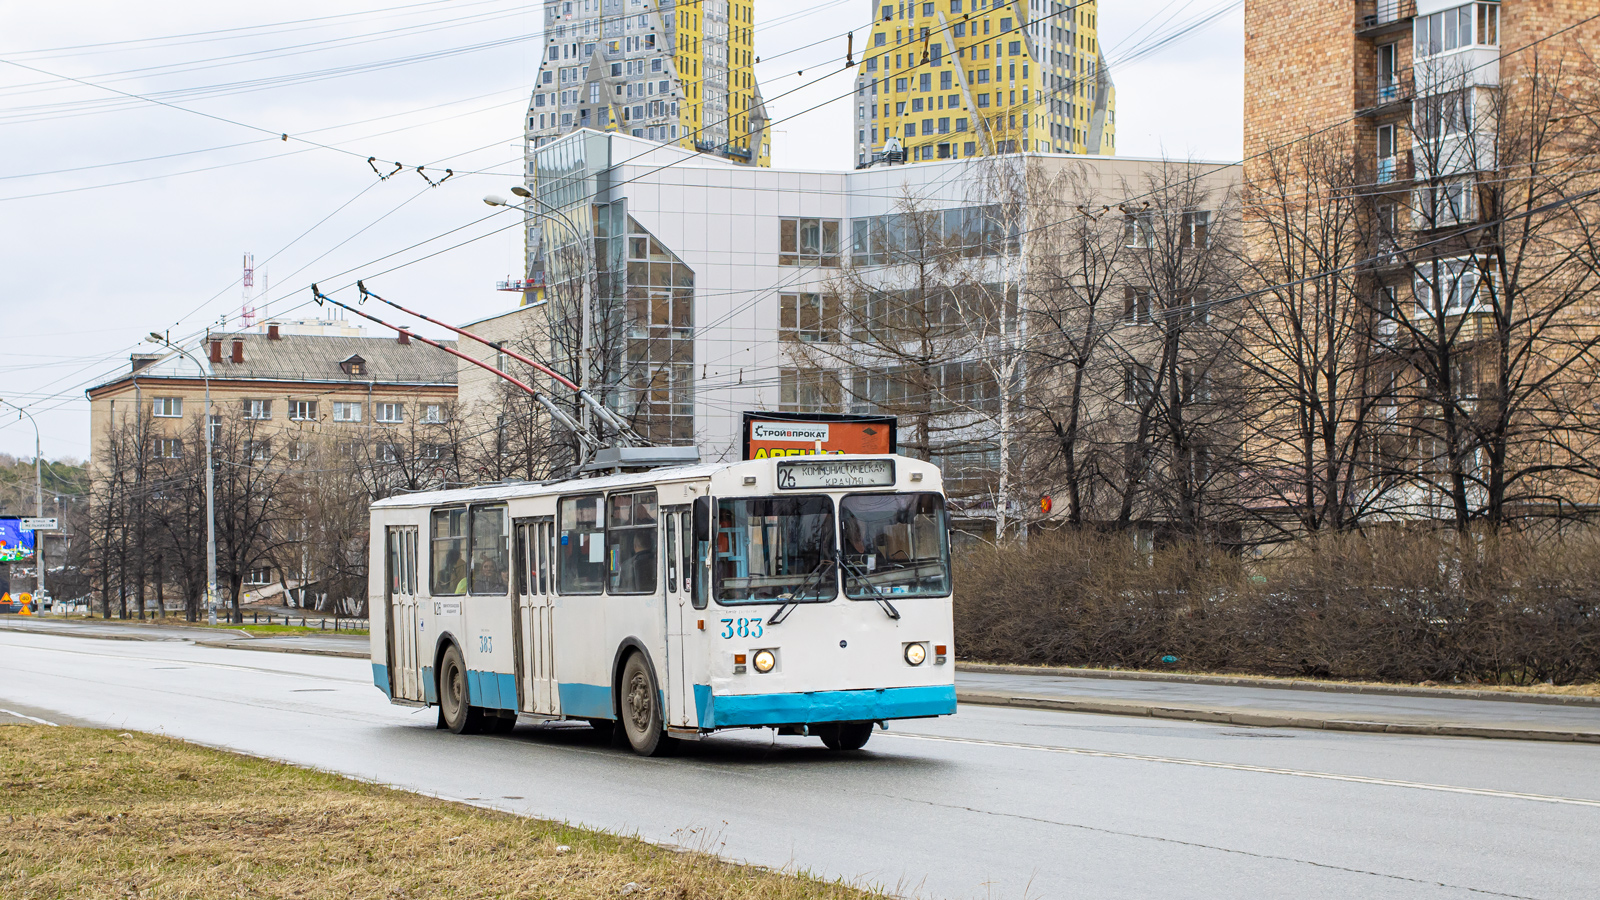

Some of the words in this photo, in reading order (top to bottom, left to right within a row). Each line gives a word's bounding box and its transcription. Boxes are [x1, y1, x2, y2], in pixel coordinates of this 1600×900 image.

[779, 468, 796, 488] 26
[802, 463, 886, 476] КОММУНИСТИЧЕСКАЯ
[720, 617, 763, 639] 383
[479, 635, 493, 653] 383
